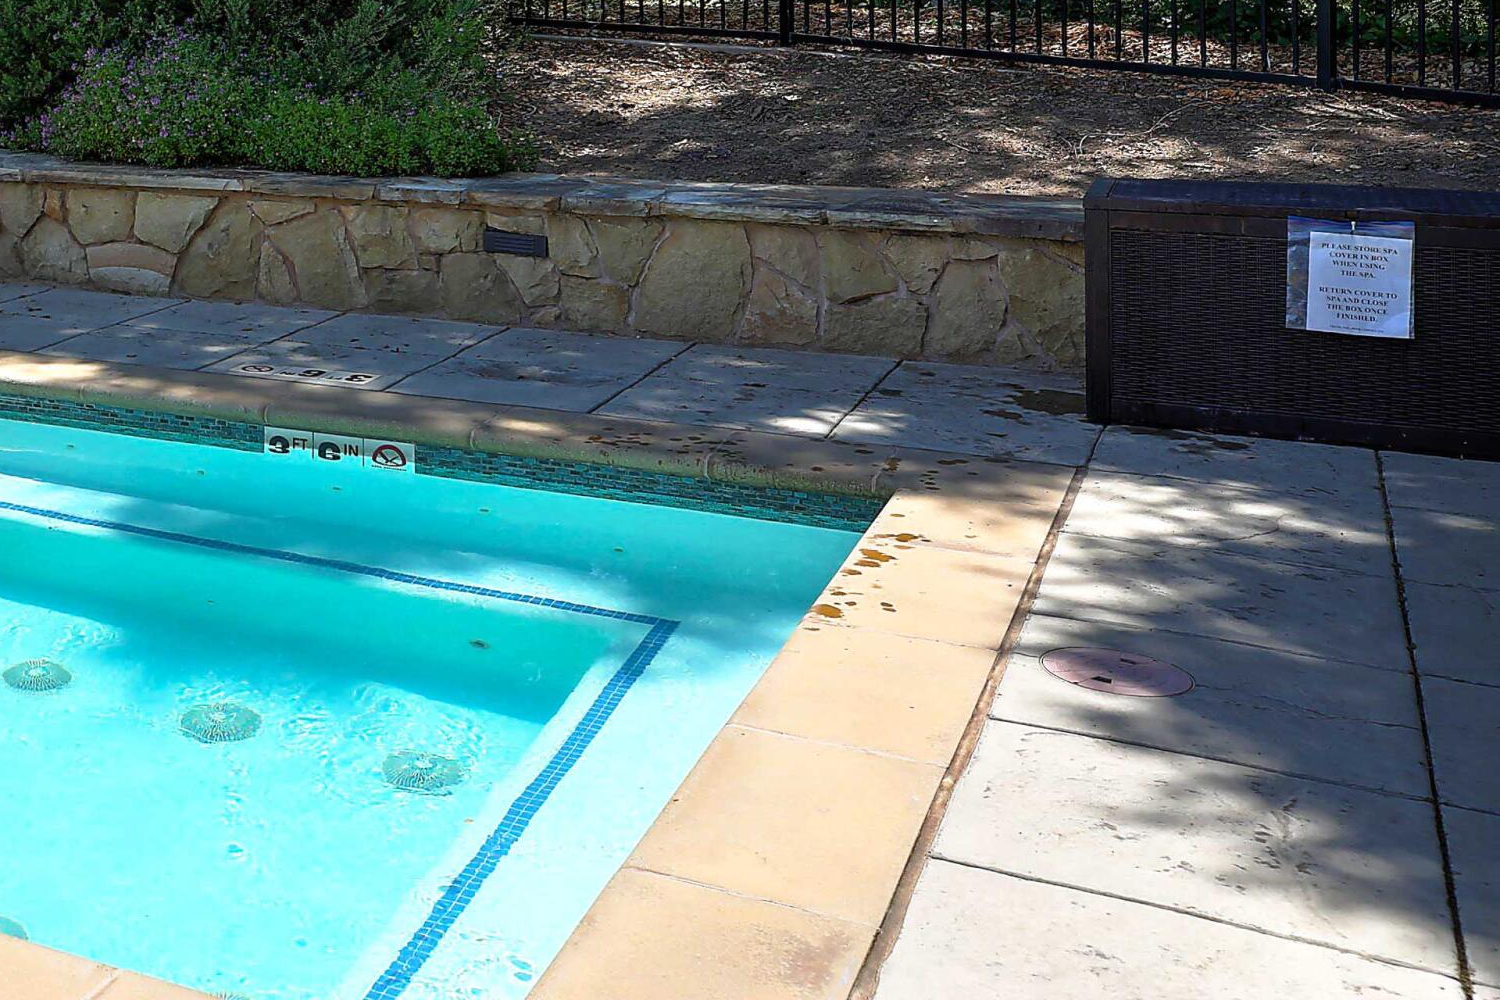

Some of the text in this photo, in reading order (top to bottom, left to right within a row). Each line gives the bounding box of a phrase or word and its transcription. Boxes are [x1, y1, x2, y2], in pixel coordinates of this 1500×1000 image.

[1360, 262, 1385, 270] USING
[1337, 313, 1378, 322] FINISHED.
[292, 438, 308, 450] FT
[344, 444, 358, 456] IN
